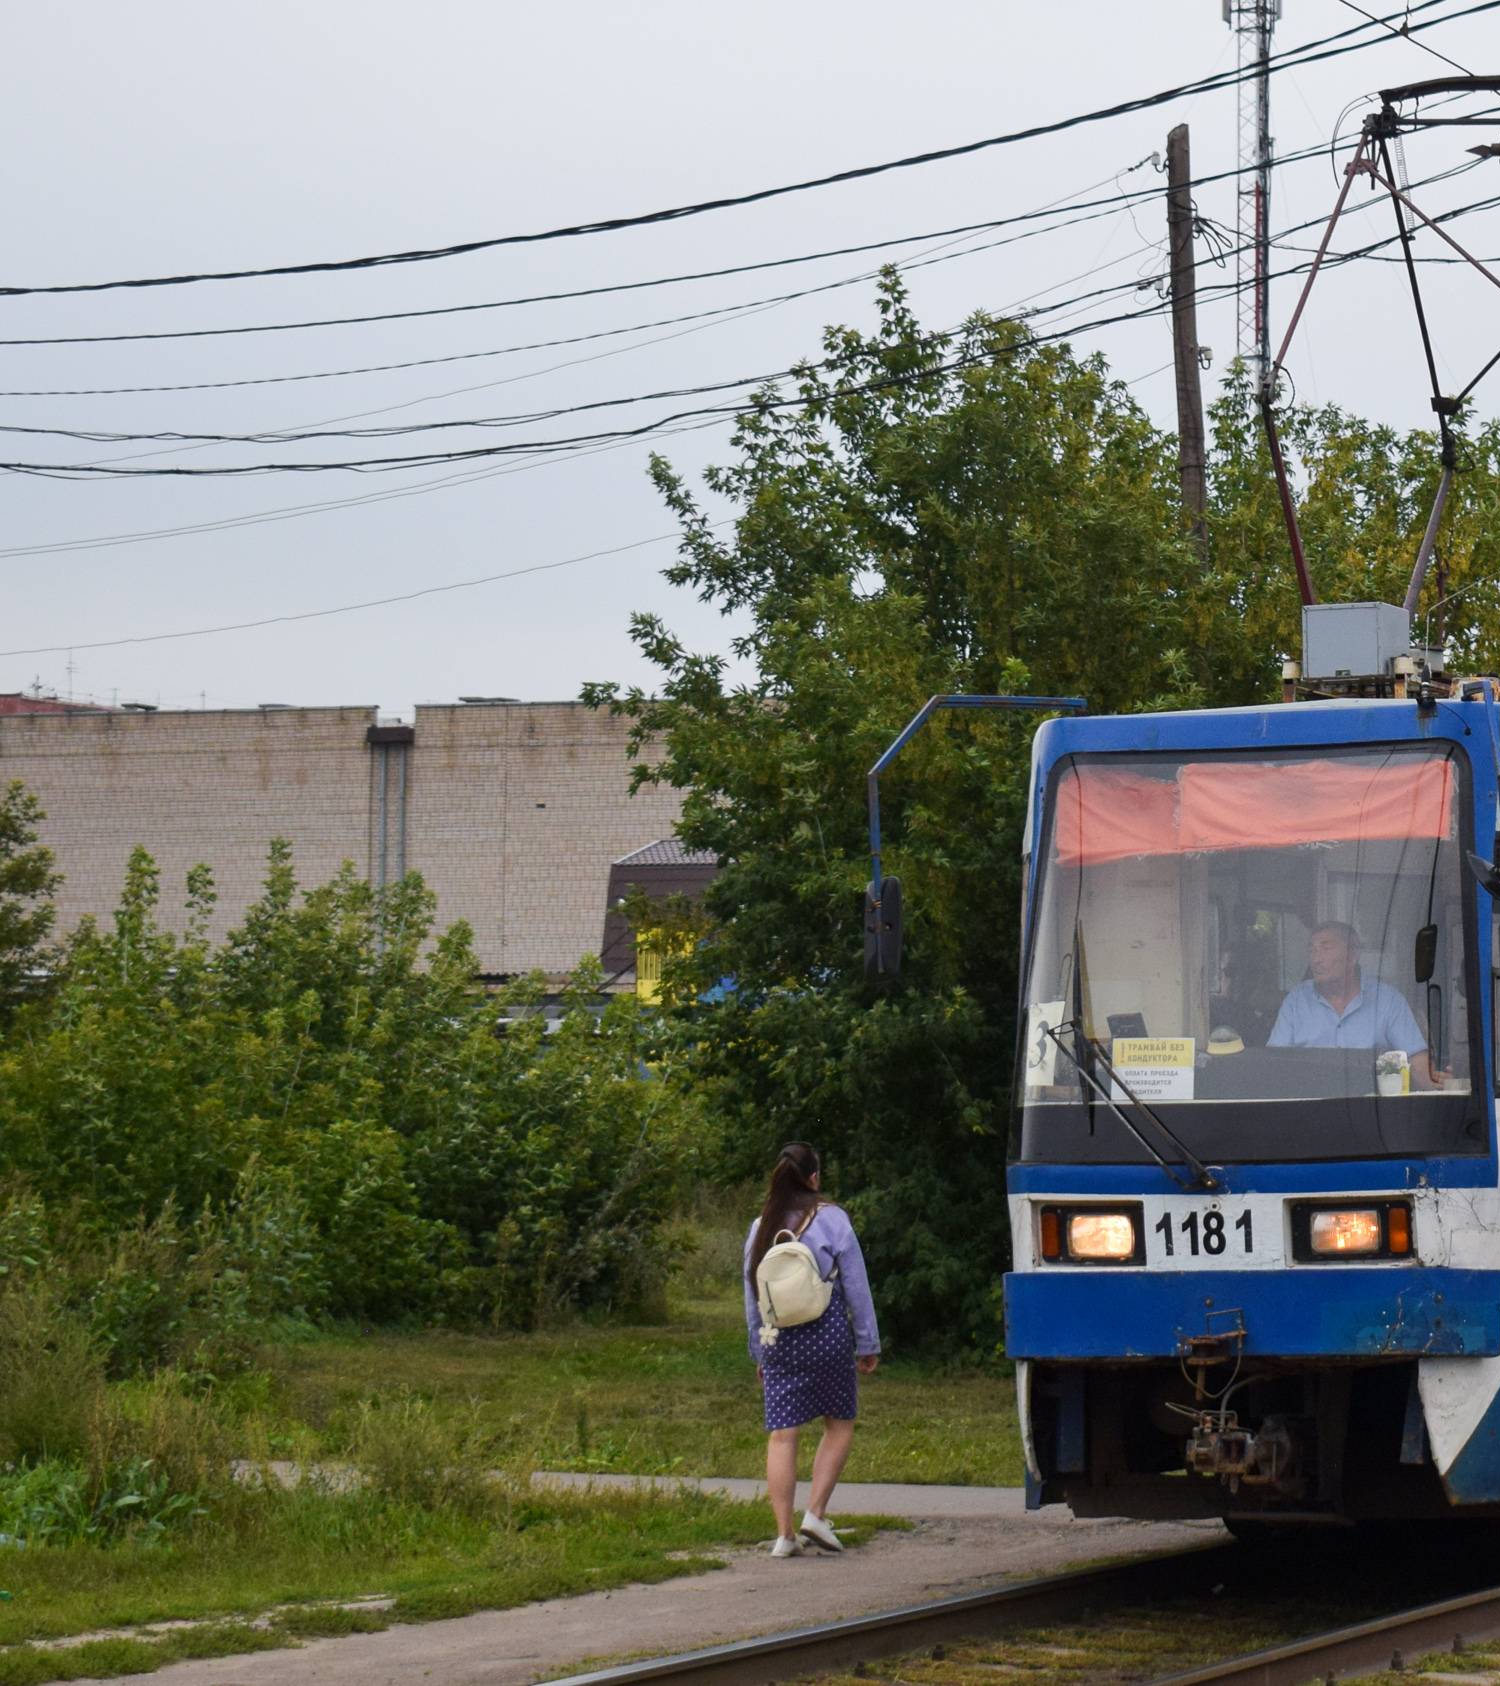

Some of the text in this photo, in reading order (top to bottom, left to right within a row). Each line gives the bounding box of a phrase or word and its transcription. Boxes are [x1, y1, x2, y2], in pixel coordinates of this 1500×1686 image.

[1128, 1041, 1185, 1052] ТРАМВАЙ БЕЗ
[1127, 1054, 1178, 1063] КОНДУКТОРА
[1155, 1208, 1254, 1257] 1181
